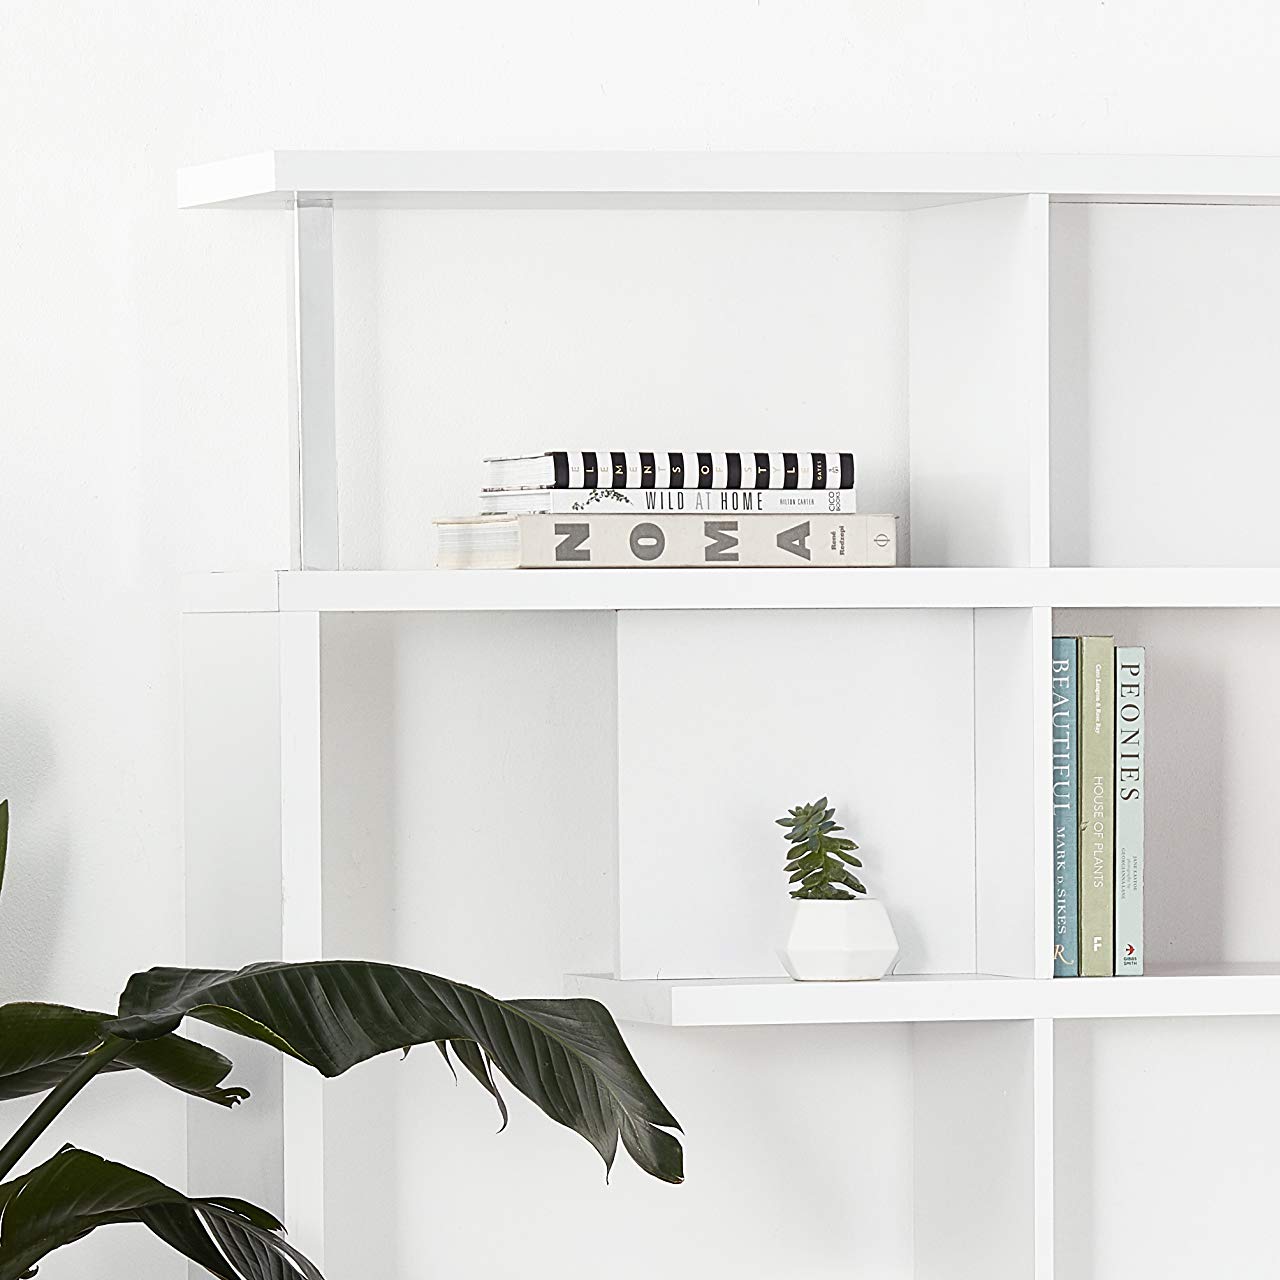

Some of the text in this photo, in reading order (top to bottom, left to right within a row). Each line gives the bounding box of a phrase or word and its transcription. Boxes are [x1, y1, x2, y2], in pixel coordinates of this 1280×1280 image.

[645, 491, 763, 510] WILD AT HOME
[554, 520, 811, 561] NOMA
[1052, 659, 1070, 815] BEAUTIFUL
[1119, 663, 1141, 801] PEONIES
[1057, 826, 1066, 870] MARK
[1093, 776, 1104, 888] HOUSE OF PLANTS
[1057, 888, 1067, 934] SIKES
